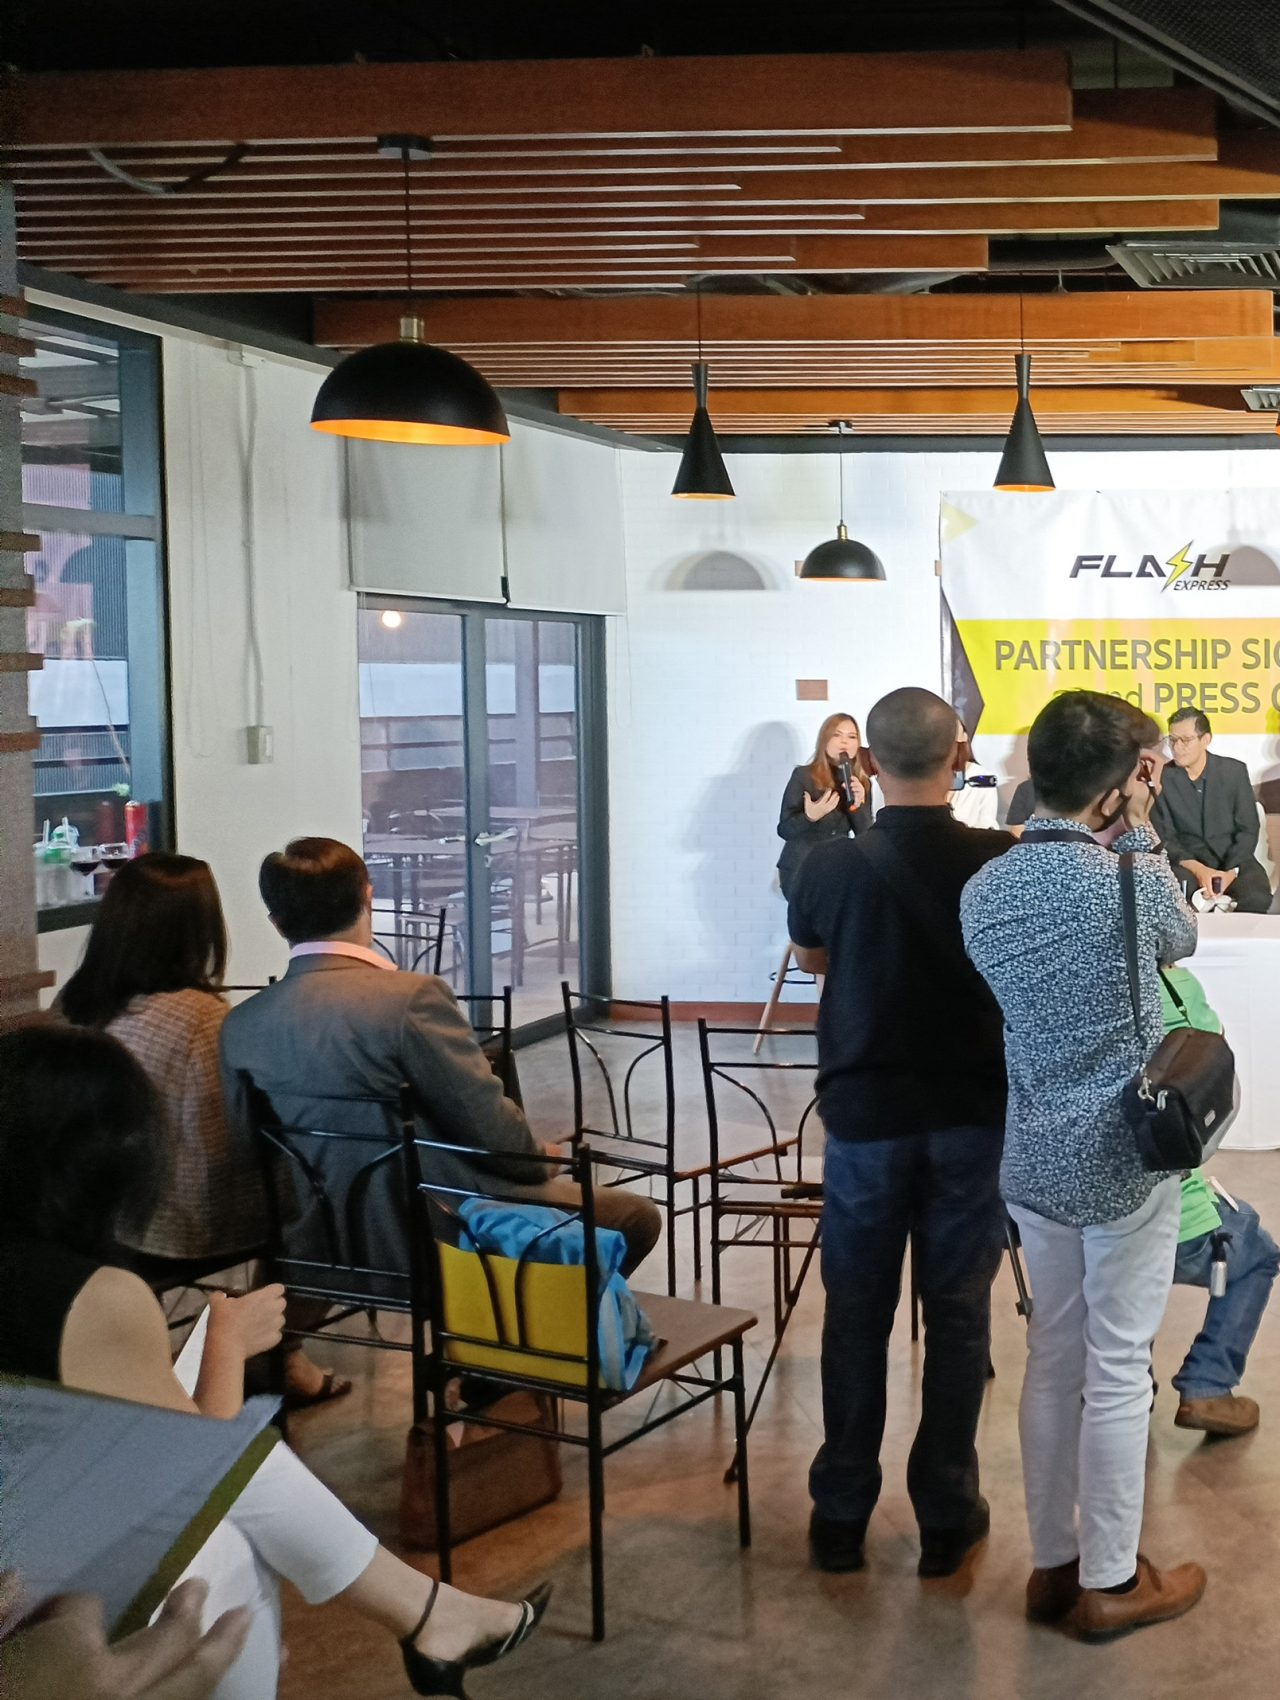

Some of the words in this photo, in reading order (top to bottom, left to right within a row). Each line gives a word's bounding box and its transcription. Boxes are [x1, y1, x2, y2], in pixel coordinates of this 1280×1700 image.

[1173, 579, 1231, 592] EXPRESS
[995, 638, 1232, 671] PARTNERSHIP
[1154, 681, 1261, 714] PRESS
